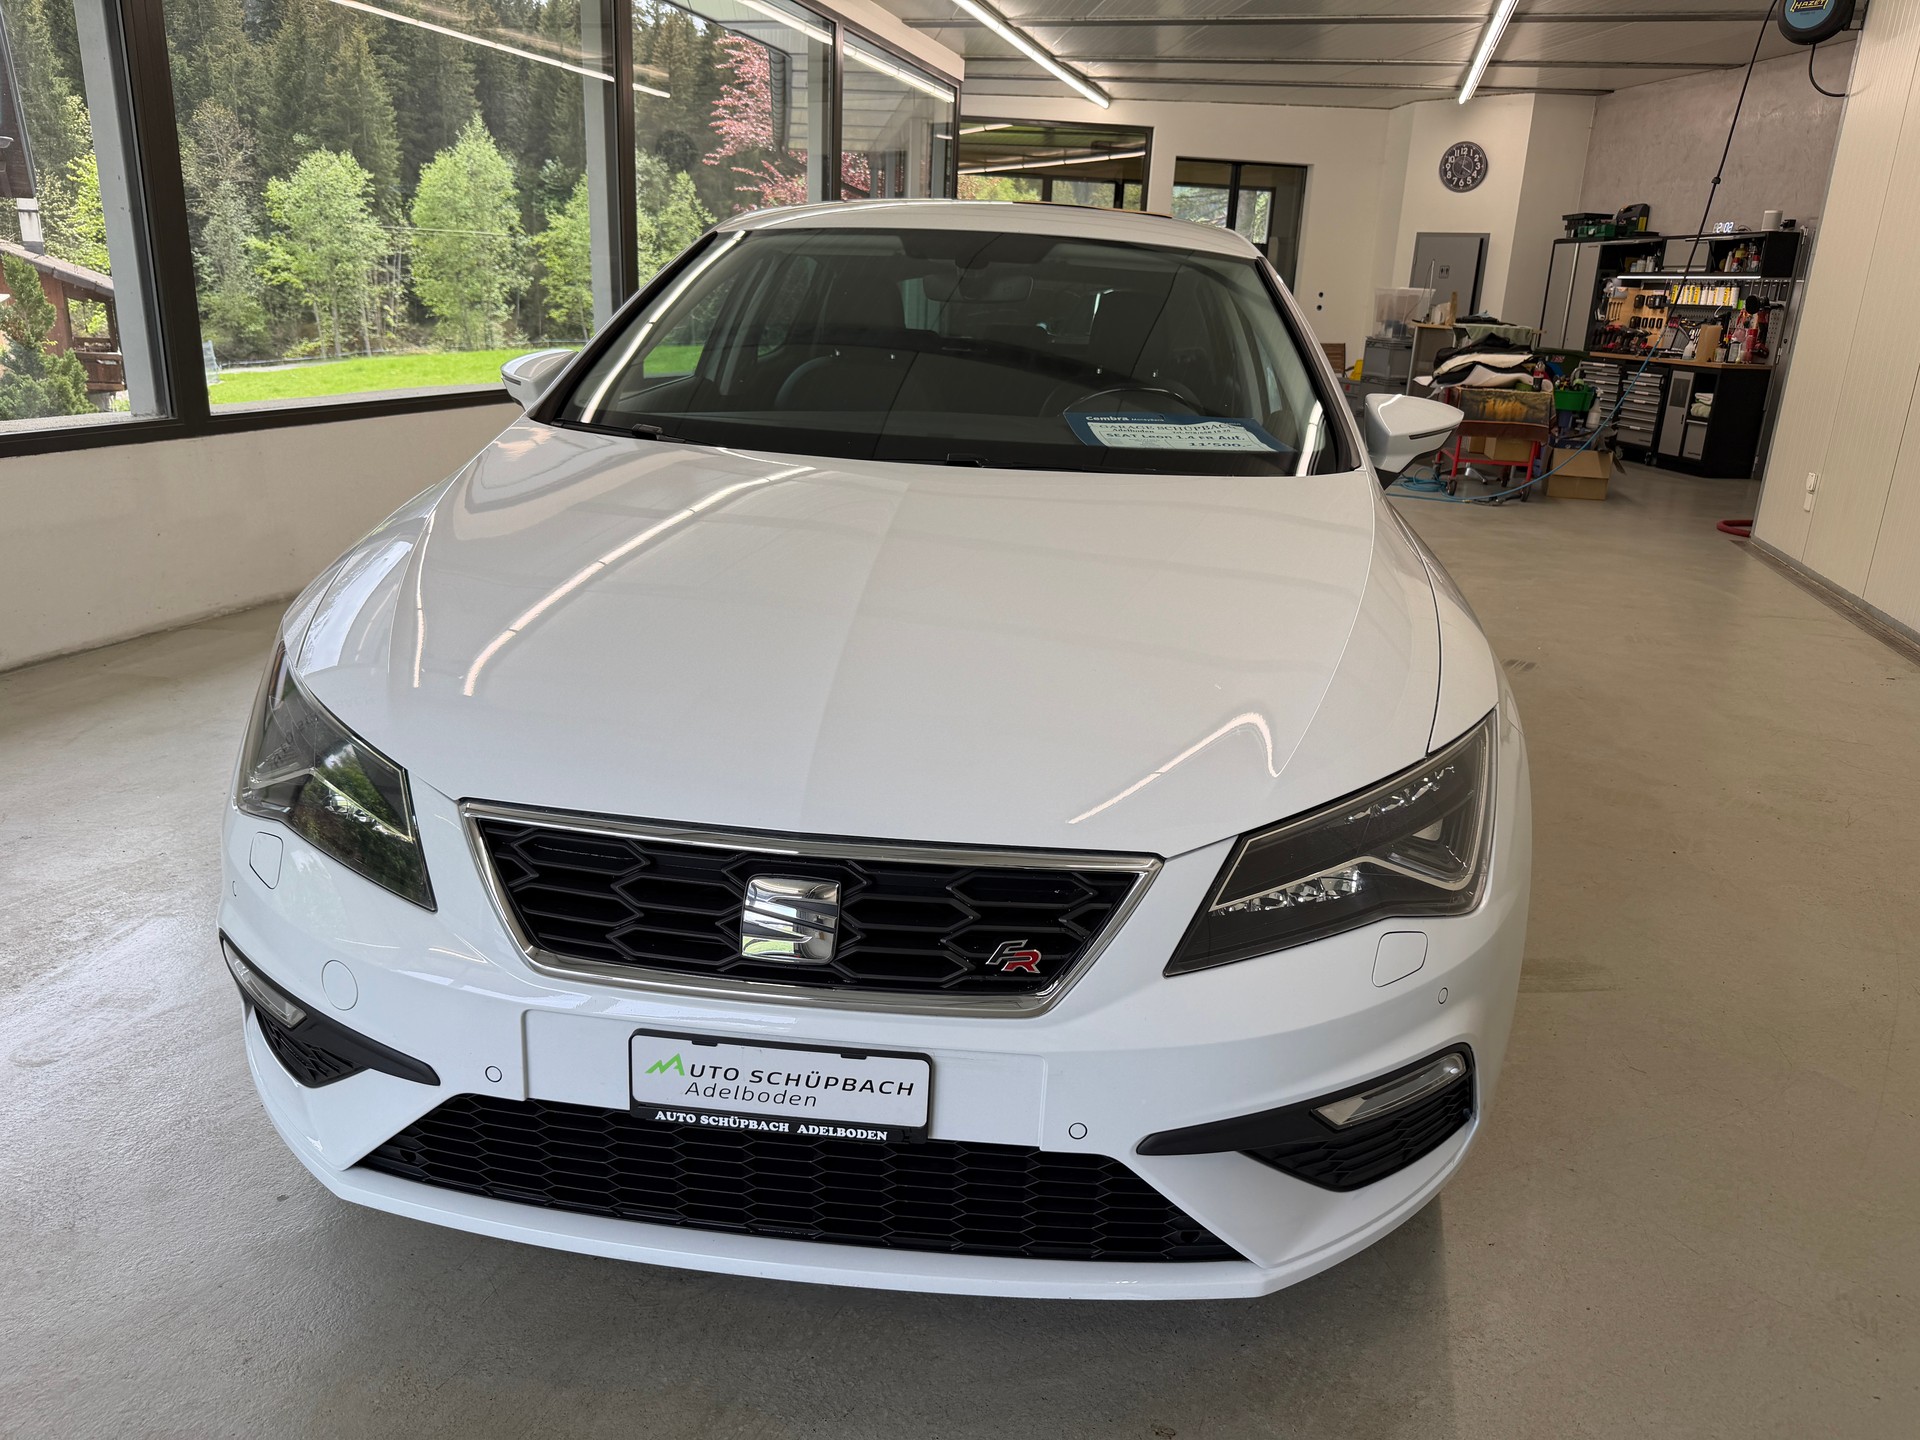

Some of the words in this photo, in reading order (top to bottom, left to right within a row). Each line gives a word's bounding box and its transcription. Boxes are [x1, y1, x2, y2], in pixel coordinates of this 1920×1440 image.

[1460, 147, 1468, 155] 12
[1445, 163, 1451, 171] 9
[1472, 170, 1477, 178] 4
[1452, 177, 1457, 185] 7
[1459, 179, 1464, 187] 6
[985, 939, 1042, 974] FR
[749, 1070, 914, 1096] SCHÜPBACH
[684, 1081, 817, 1107] Adelboden
[655, 1110, 696, 1123] AUTO
[699, 1115, 789, 1132] SCHÜPBACH
[797, 1124, 888, 1141] ADELBODEN
